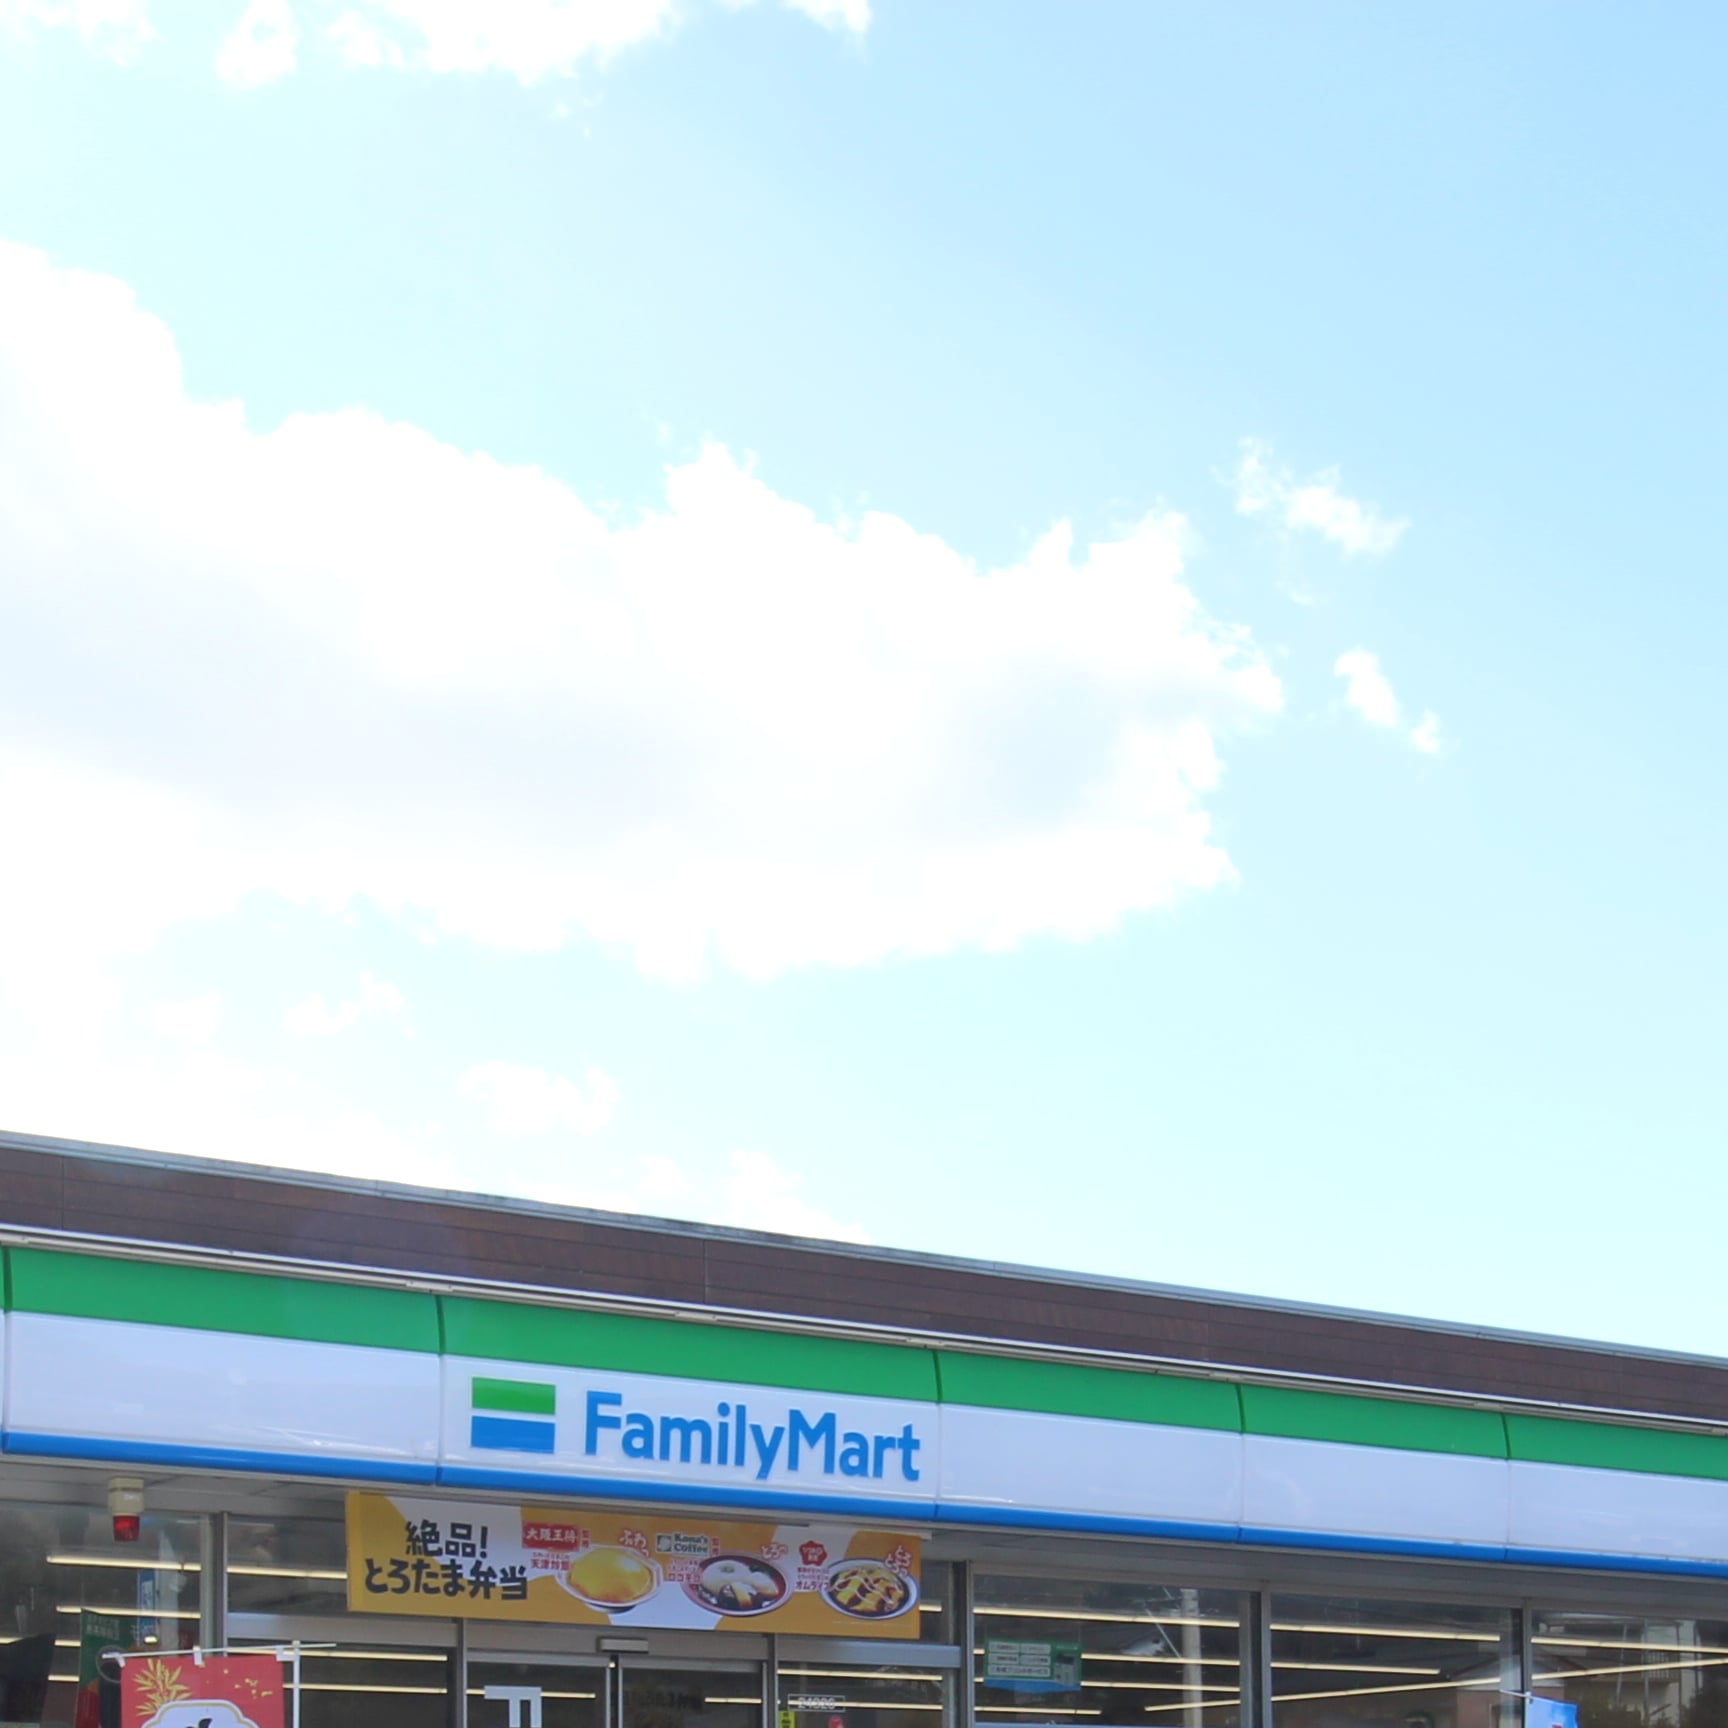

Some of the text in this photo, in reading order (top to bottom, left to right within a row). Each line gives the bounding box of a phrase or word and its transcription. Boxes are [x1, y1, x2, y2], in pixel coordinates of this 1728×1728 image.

[585, 1390, 920, 1481] FamilyMart
[405, 1519, 488, 1559] 絶品!
[364, 1558, 528, 1600] とろたま弁当
